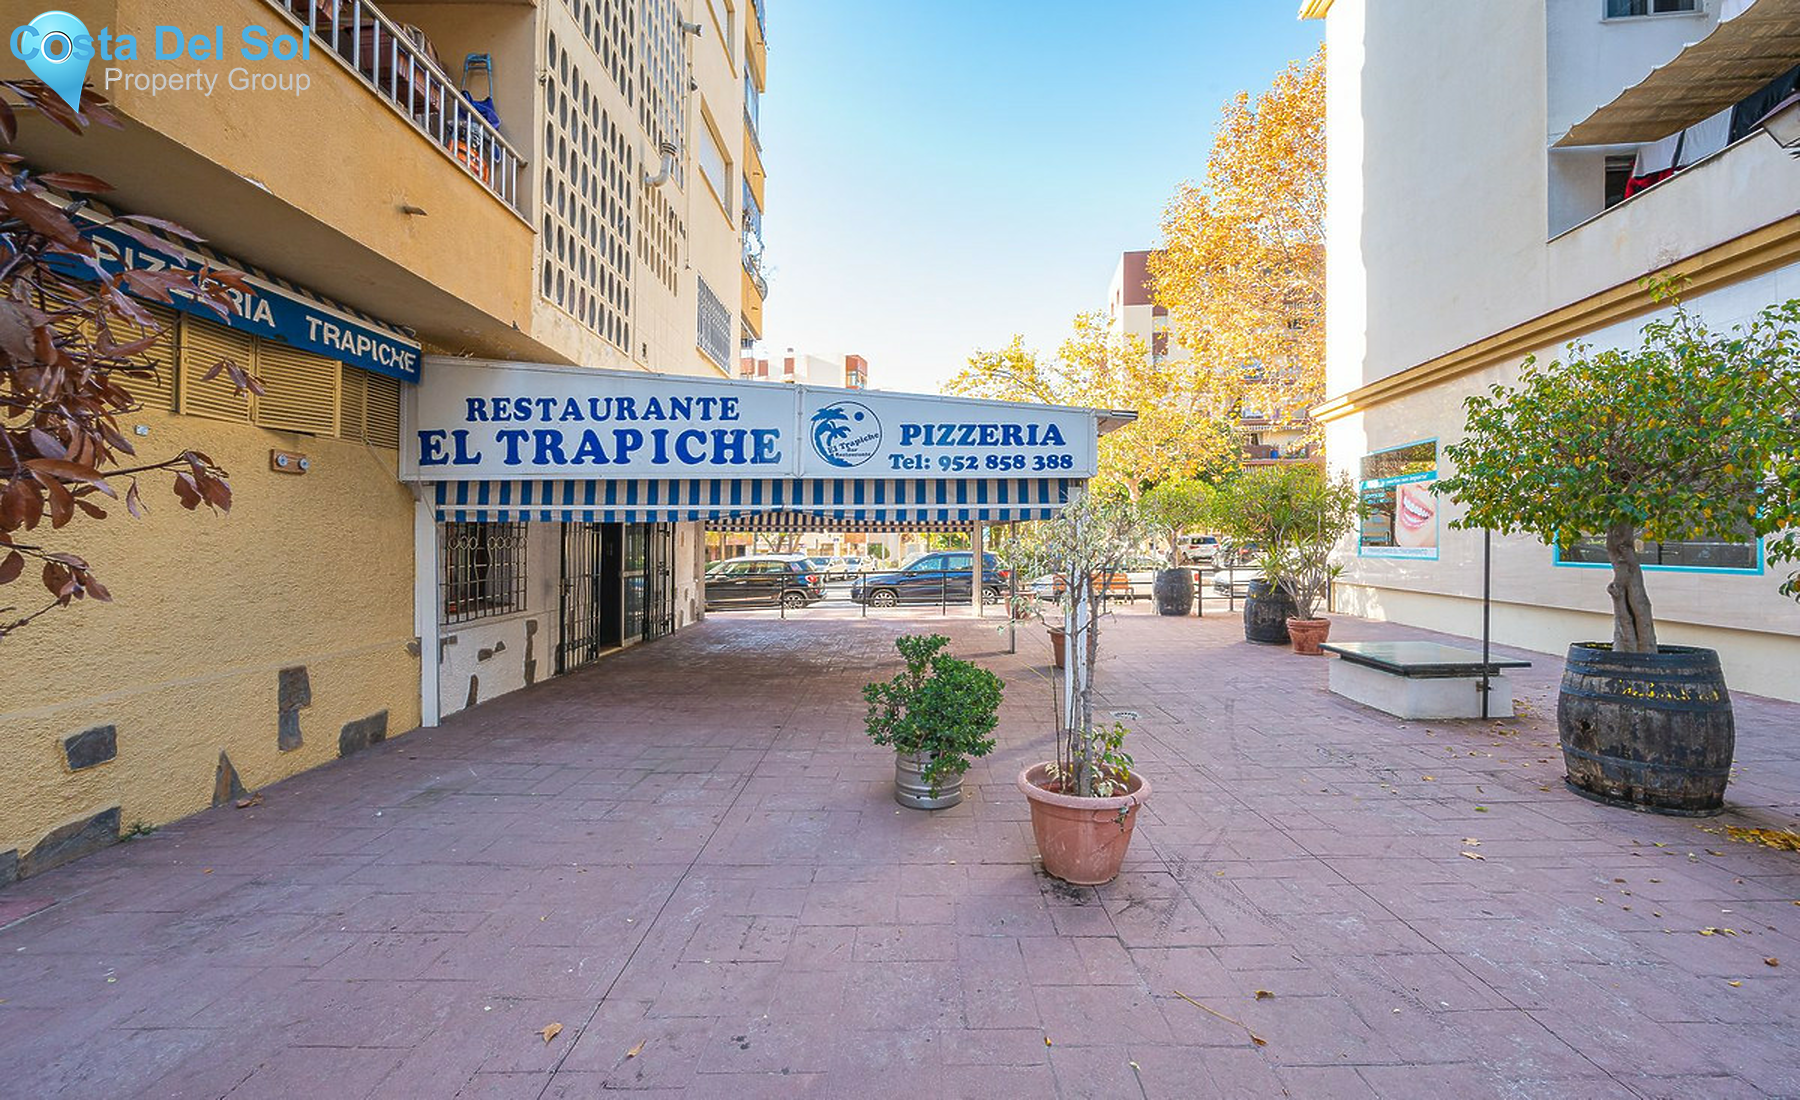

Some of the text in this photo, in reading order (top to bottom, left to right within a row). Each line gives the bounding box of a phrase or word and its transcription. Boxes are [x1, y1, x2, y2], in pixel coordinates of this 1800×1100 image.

[306, 315, 416, 373] TRAPICHE
[466, 396, 740, 422] RESTAURANTE
[418, 428, 782, 465] EL TRAPICHE
[839, 433, 879, 449] Trapiche
[899, 423, 1067, 447] PIZZERIA
[888, 453, 1074, 472] Tel: 952 858 388
